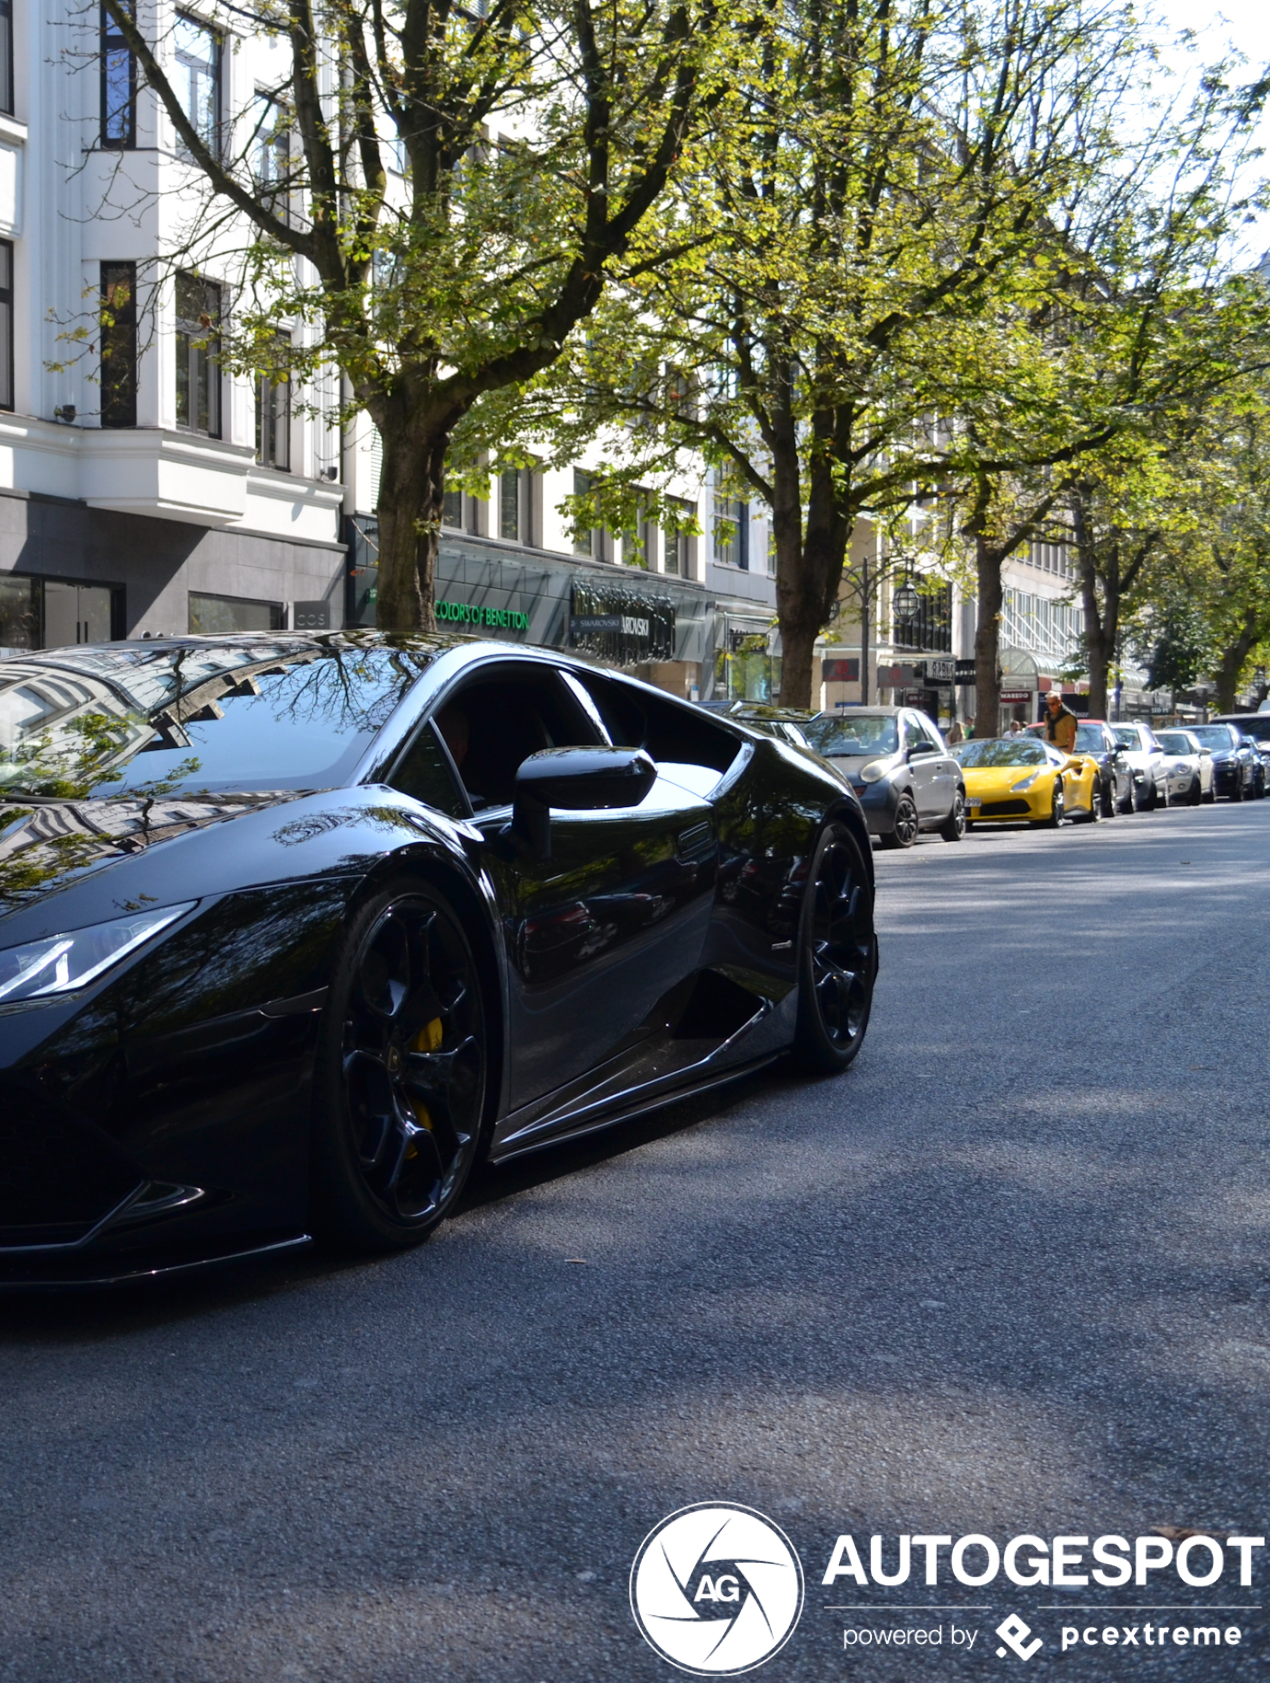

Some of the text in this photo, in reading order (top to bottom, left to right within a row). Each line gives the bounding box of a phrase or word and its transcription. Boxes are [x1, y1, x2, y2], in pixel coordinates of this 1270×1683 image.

[434, 600, 470, 623] COLORS
[471, 605, 484, 624] OF
[297, 613, 325, 626] COS
[580, 619, 619, 628] SWAROVSKI
